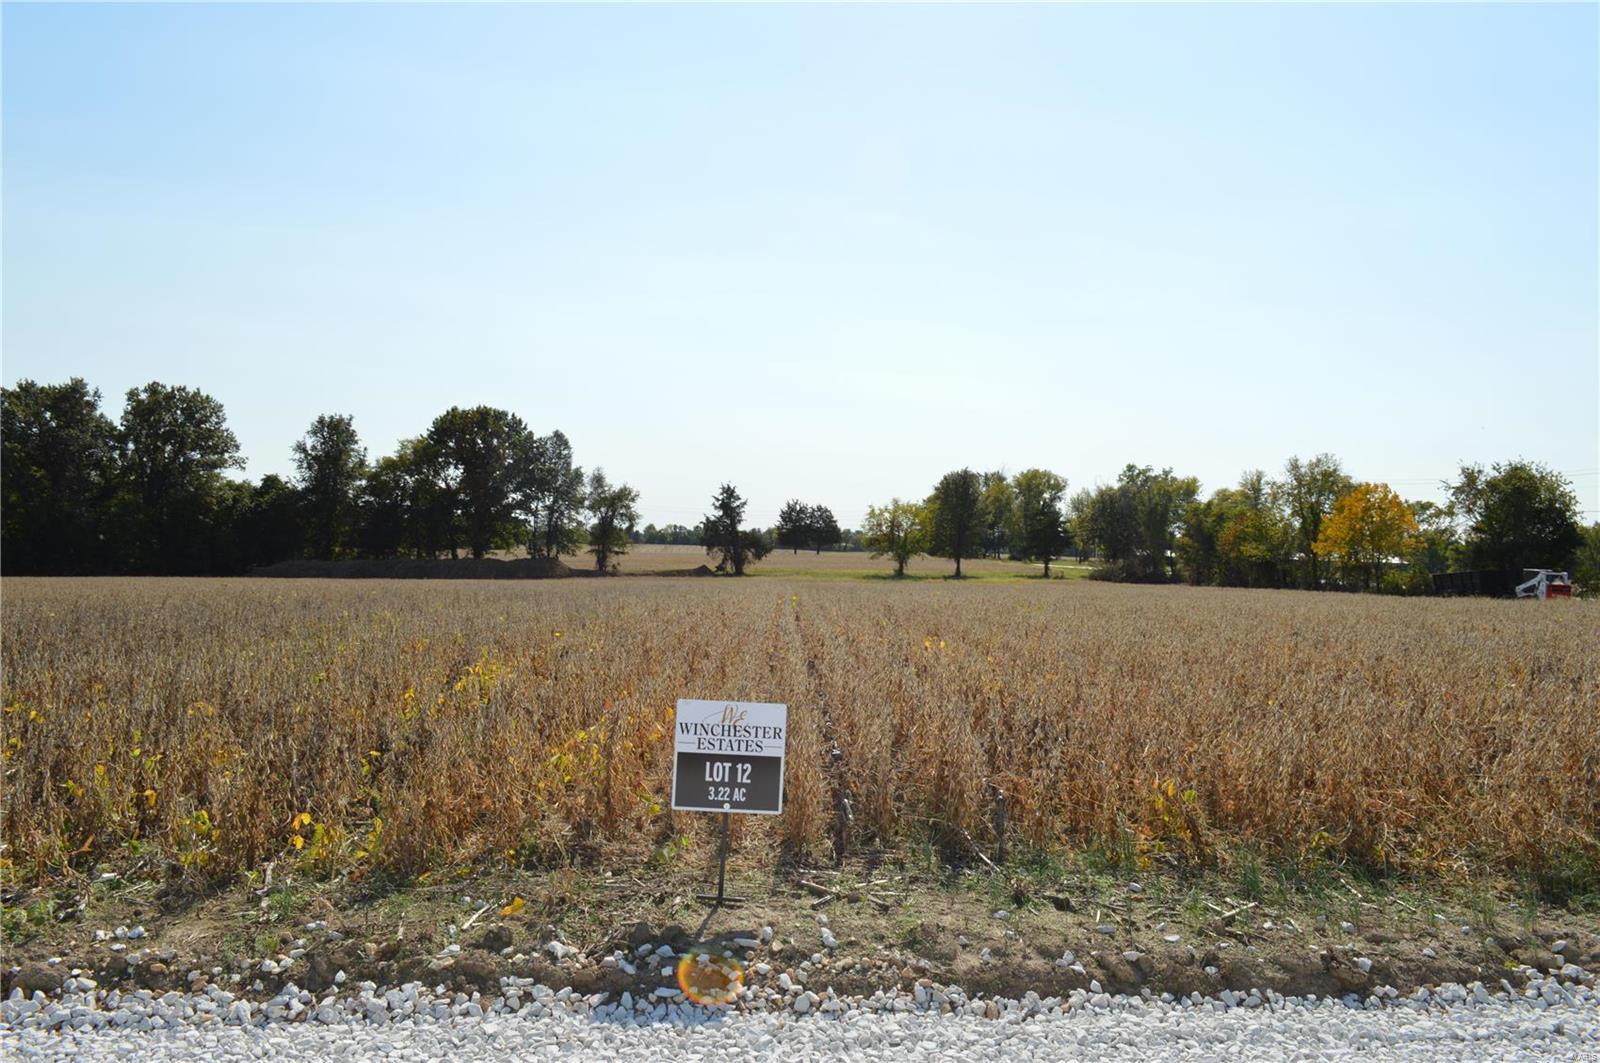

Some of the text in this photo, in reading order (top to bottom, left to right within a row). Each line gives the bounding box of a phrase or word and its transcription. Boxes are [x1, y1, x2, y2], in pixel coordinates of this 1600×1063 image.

[680, 722, 782, 739] WINCHESTER
[697, 737, 764, 753] ESTATES
[705, 762, 752, 783] LOT 12
[708, 787, 746, 802] 3.22 AC
